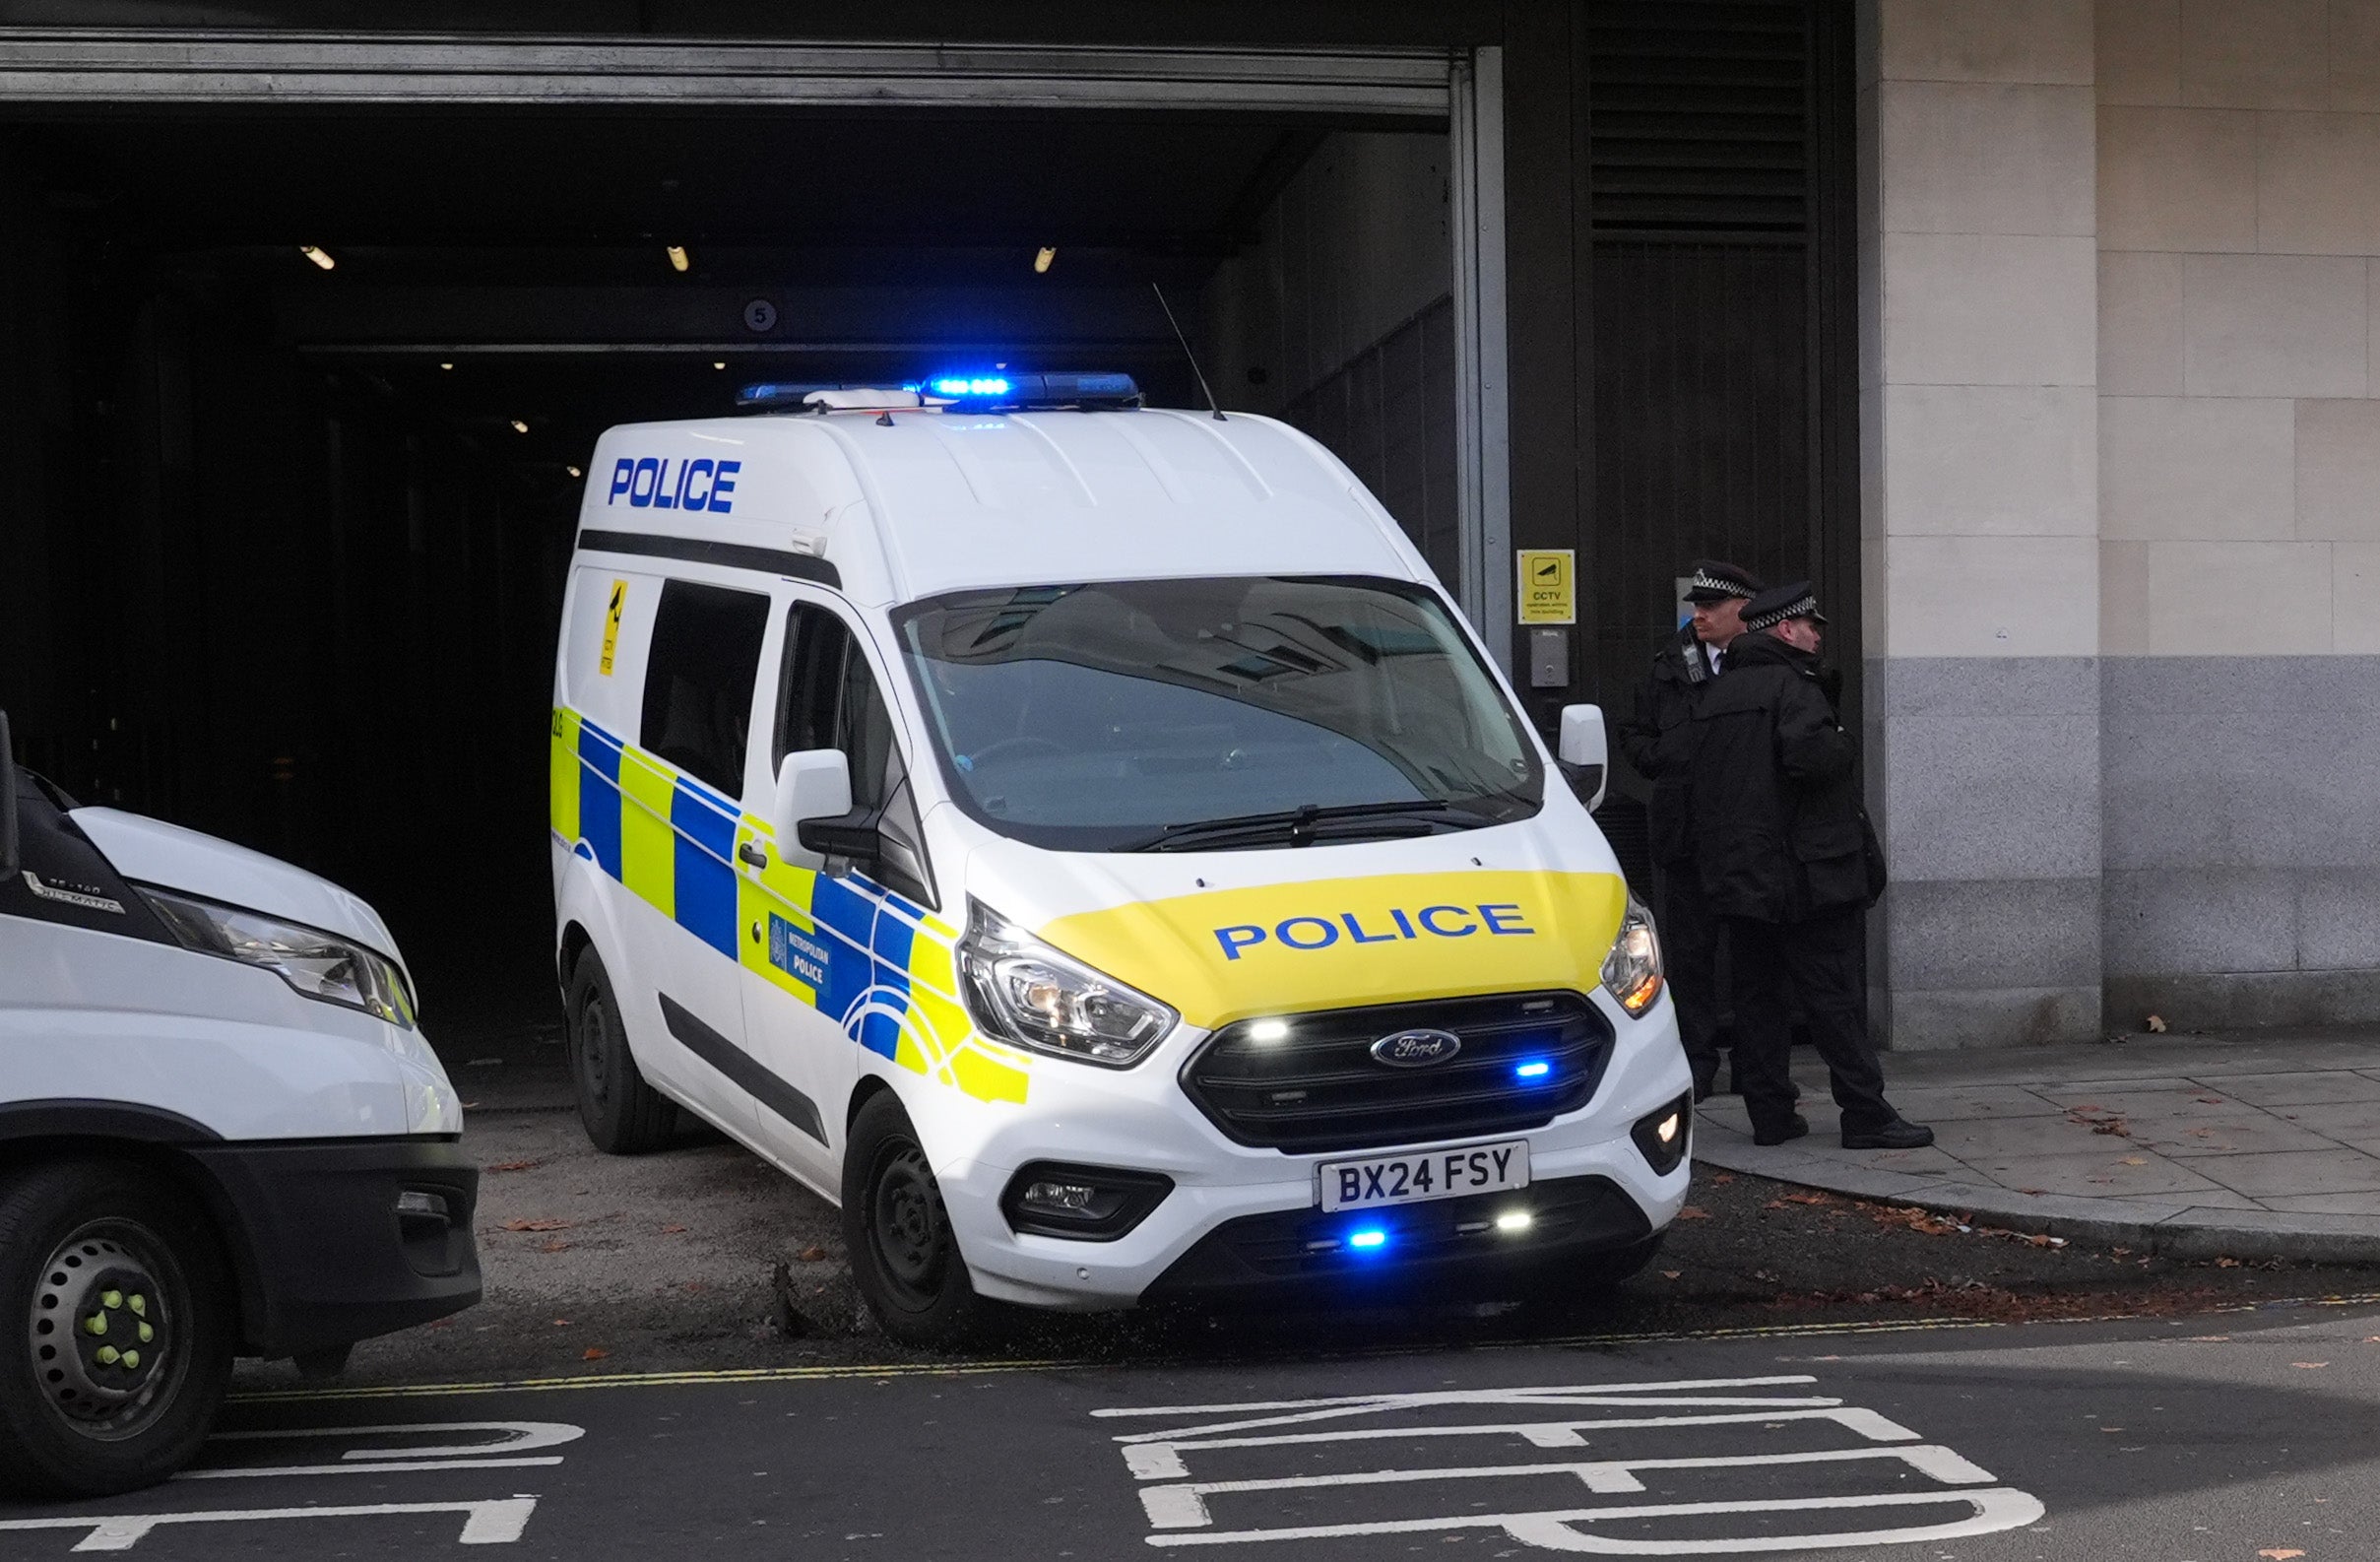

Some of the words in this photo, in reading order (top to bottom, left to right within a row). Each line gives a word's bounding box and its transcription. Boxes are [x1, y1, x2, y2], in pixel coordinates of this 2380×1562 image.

[754, 307, 767, 323] 5
[609, 458, 741, 513] POLICE
[789, 932, 829, 964] METROPOLITAN
[1214, 903, 1535, 960] POLICE
[794, 955, 823, 984] POLICE
[1394, 1034, 1443, 1057] Ford
[1340, 1158, 1433, 1203] BX24
[1446, 1148, 1512, 1190] FSY
[1089, 1375, 2046, 1556] KEEP
